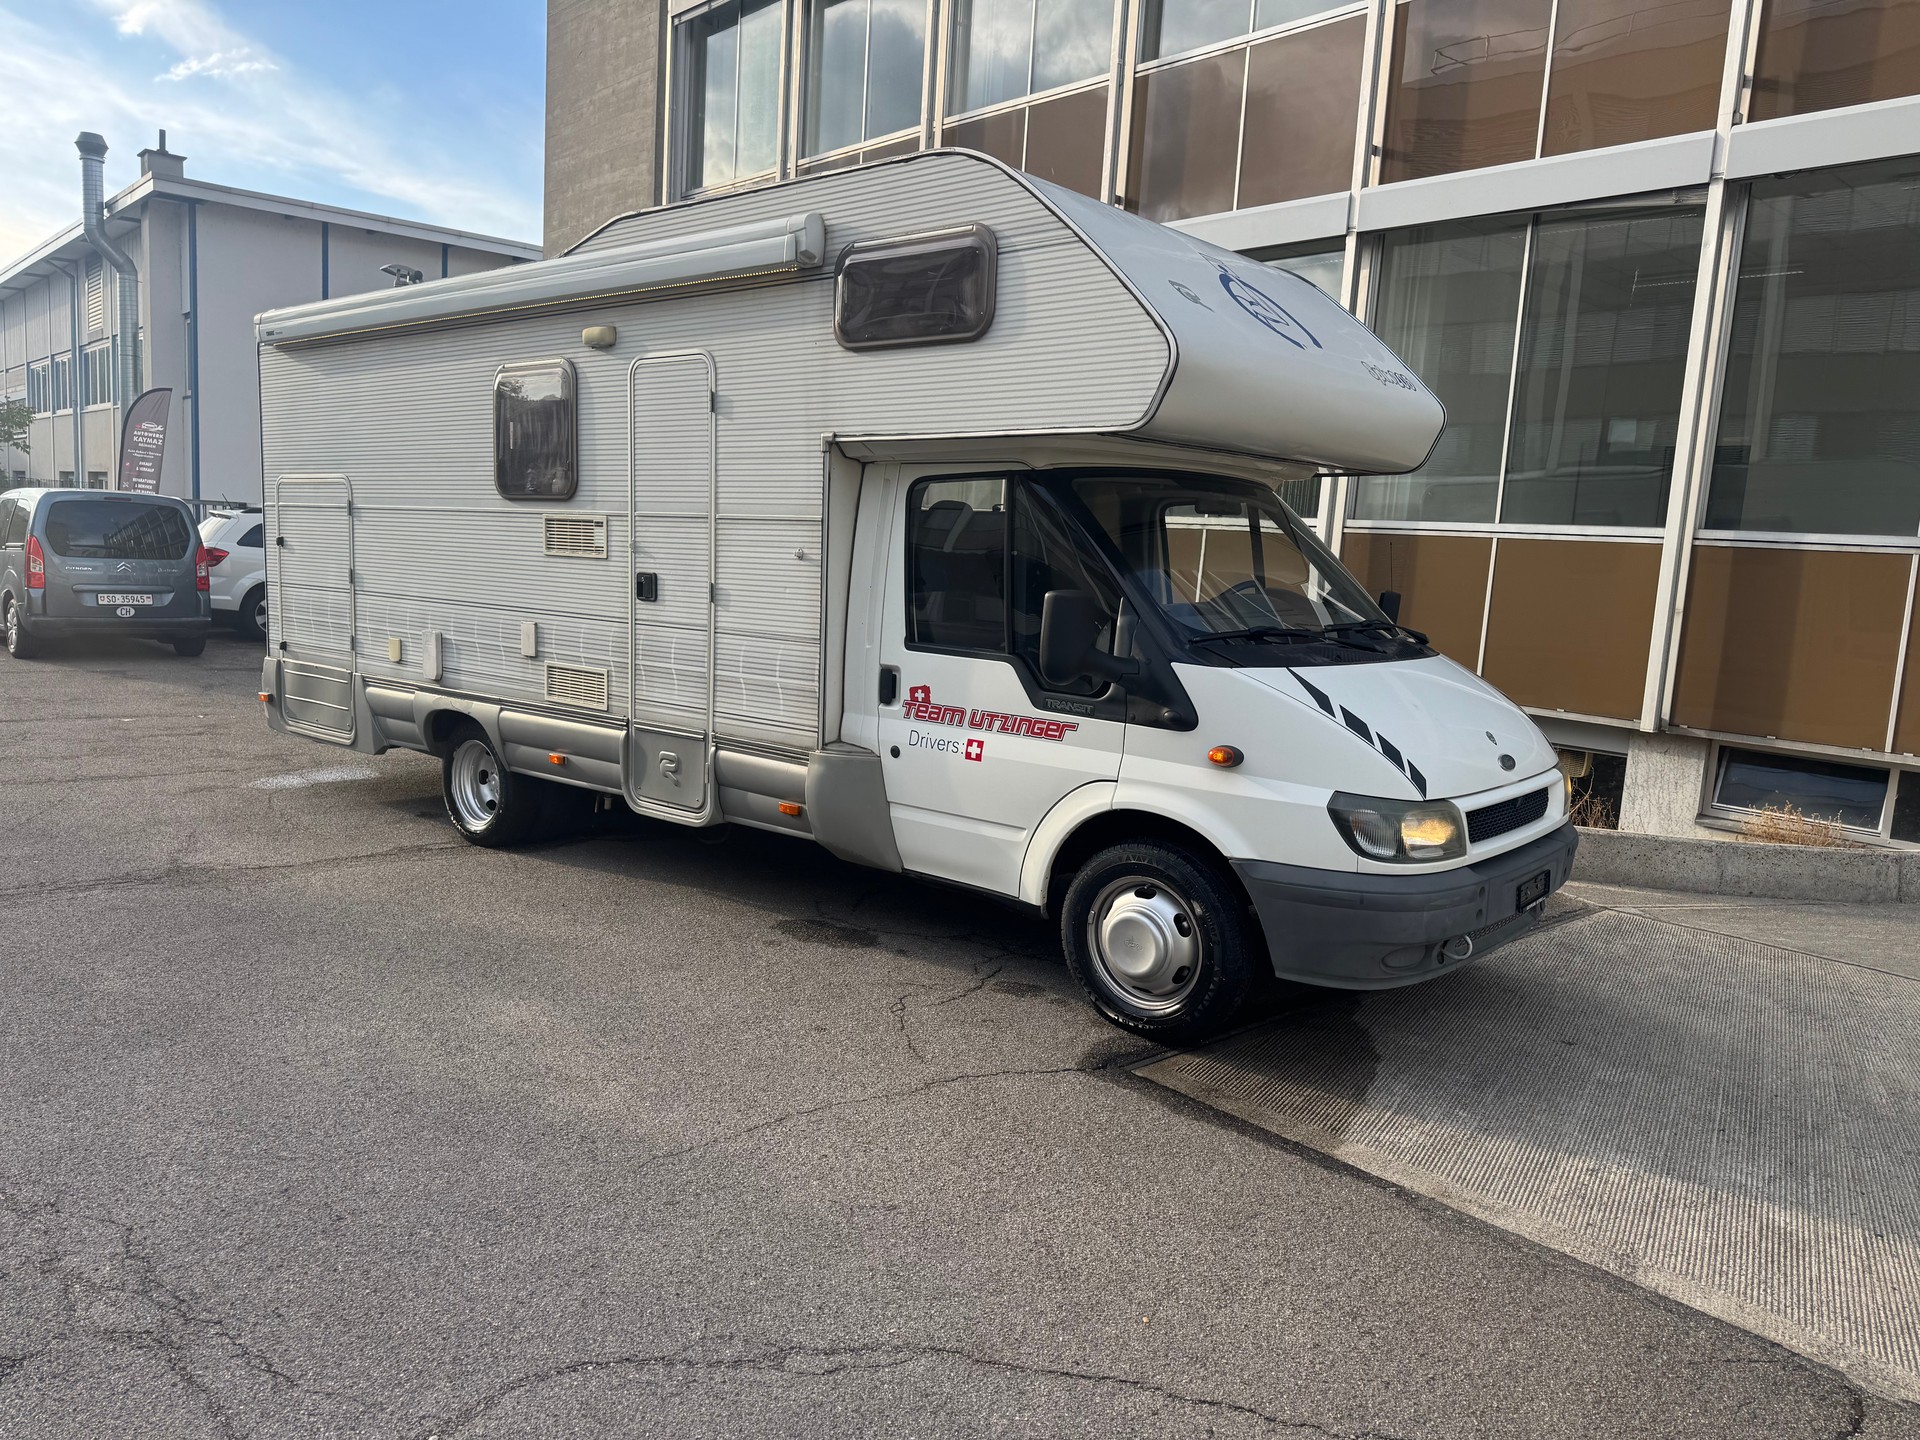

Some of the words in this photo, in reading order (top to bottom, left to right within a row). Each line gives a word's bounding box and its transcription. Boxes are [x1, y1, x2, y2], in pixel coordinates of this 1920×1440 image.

[133, 430, 164, 439] AUTOWERK
[133, 436, 163, 445] KAYMAZ
[120, 608, 131, 616] CH
[1045, 699, 1094, 714] TRANSIT
[908, 730, 965, 755] Drivers:
